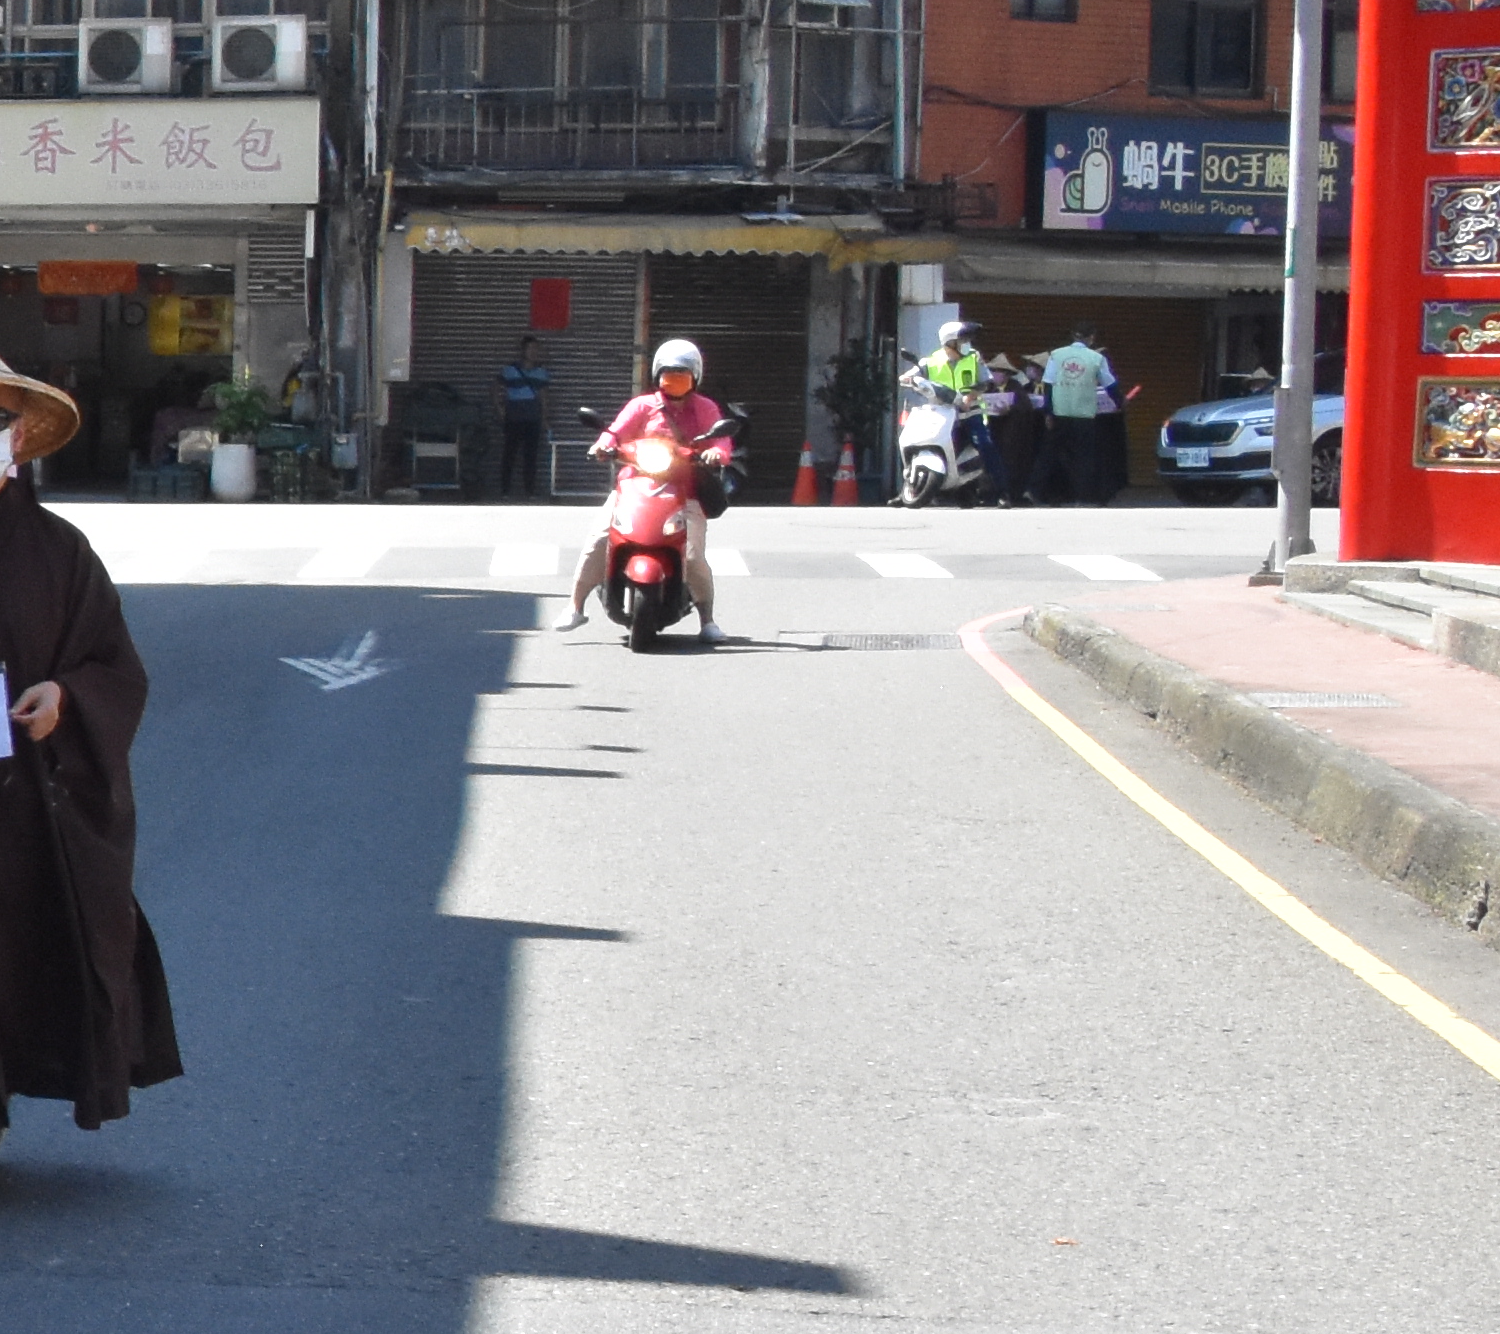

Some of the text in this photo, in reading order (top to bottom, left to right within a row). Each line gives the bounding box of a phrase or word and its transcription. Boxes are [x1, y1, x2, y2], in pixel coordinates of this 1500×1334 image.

[20, 118, 282, 174] 香米飯包
[1121, 140, 1195, 191] 蝸牛
[1159, 199, 1206, 215] Mobile
[1210, 199, 1254, 215] Phone
